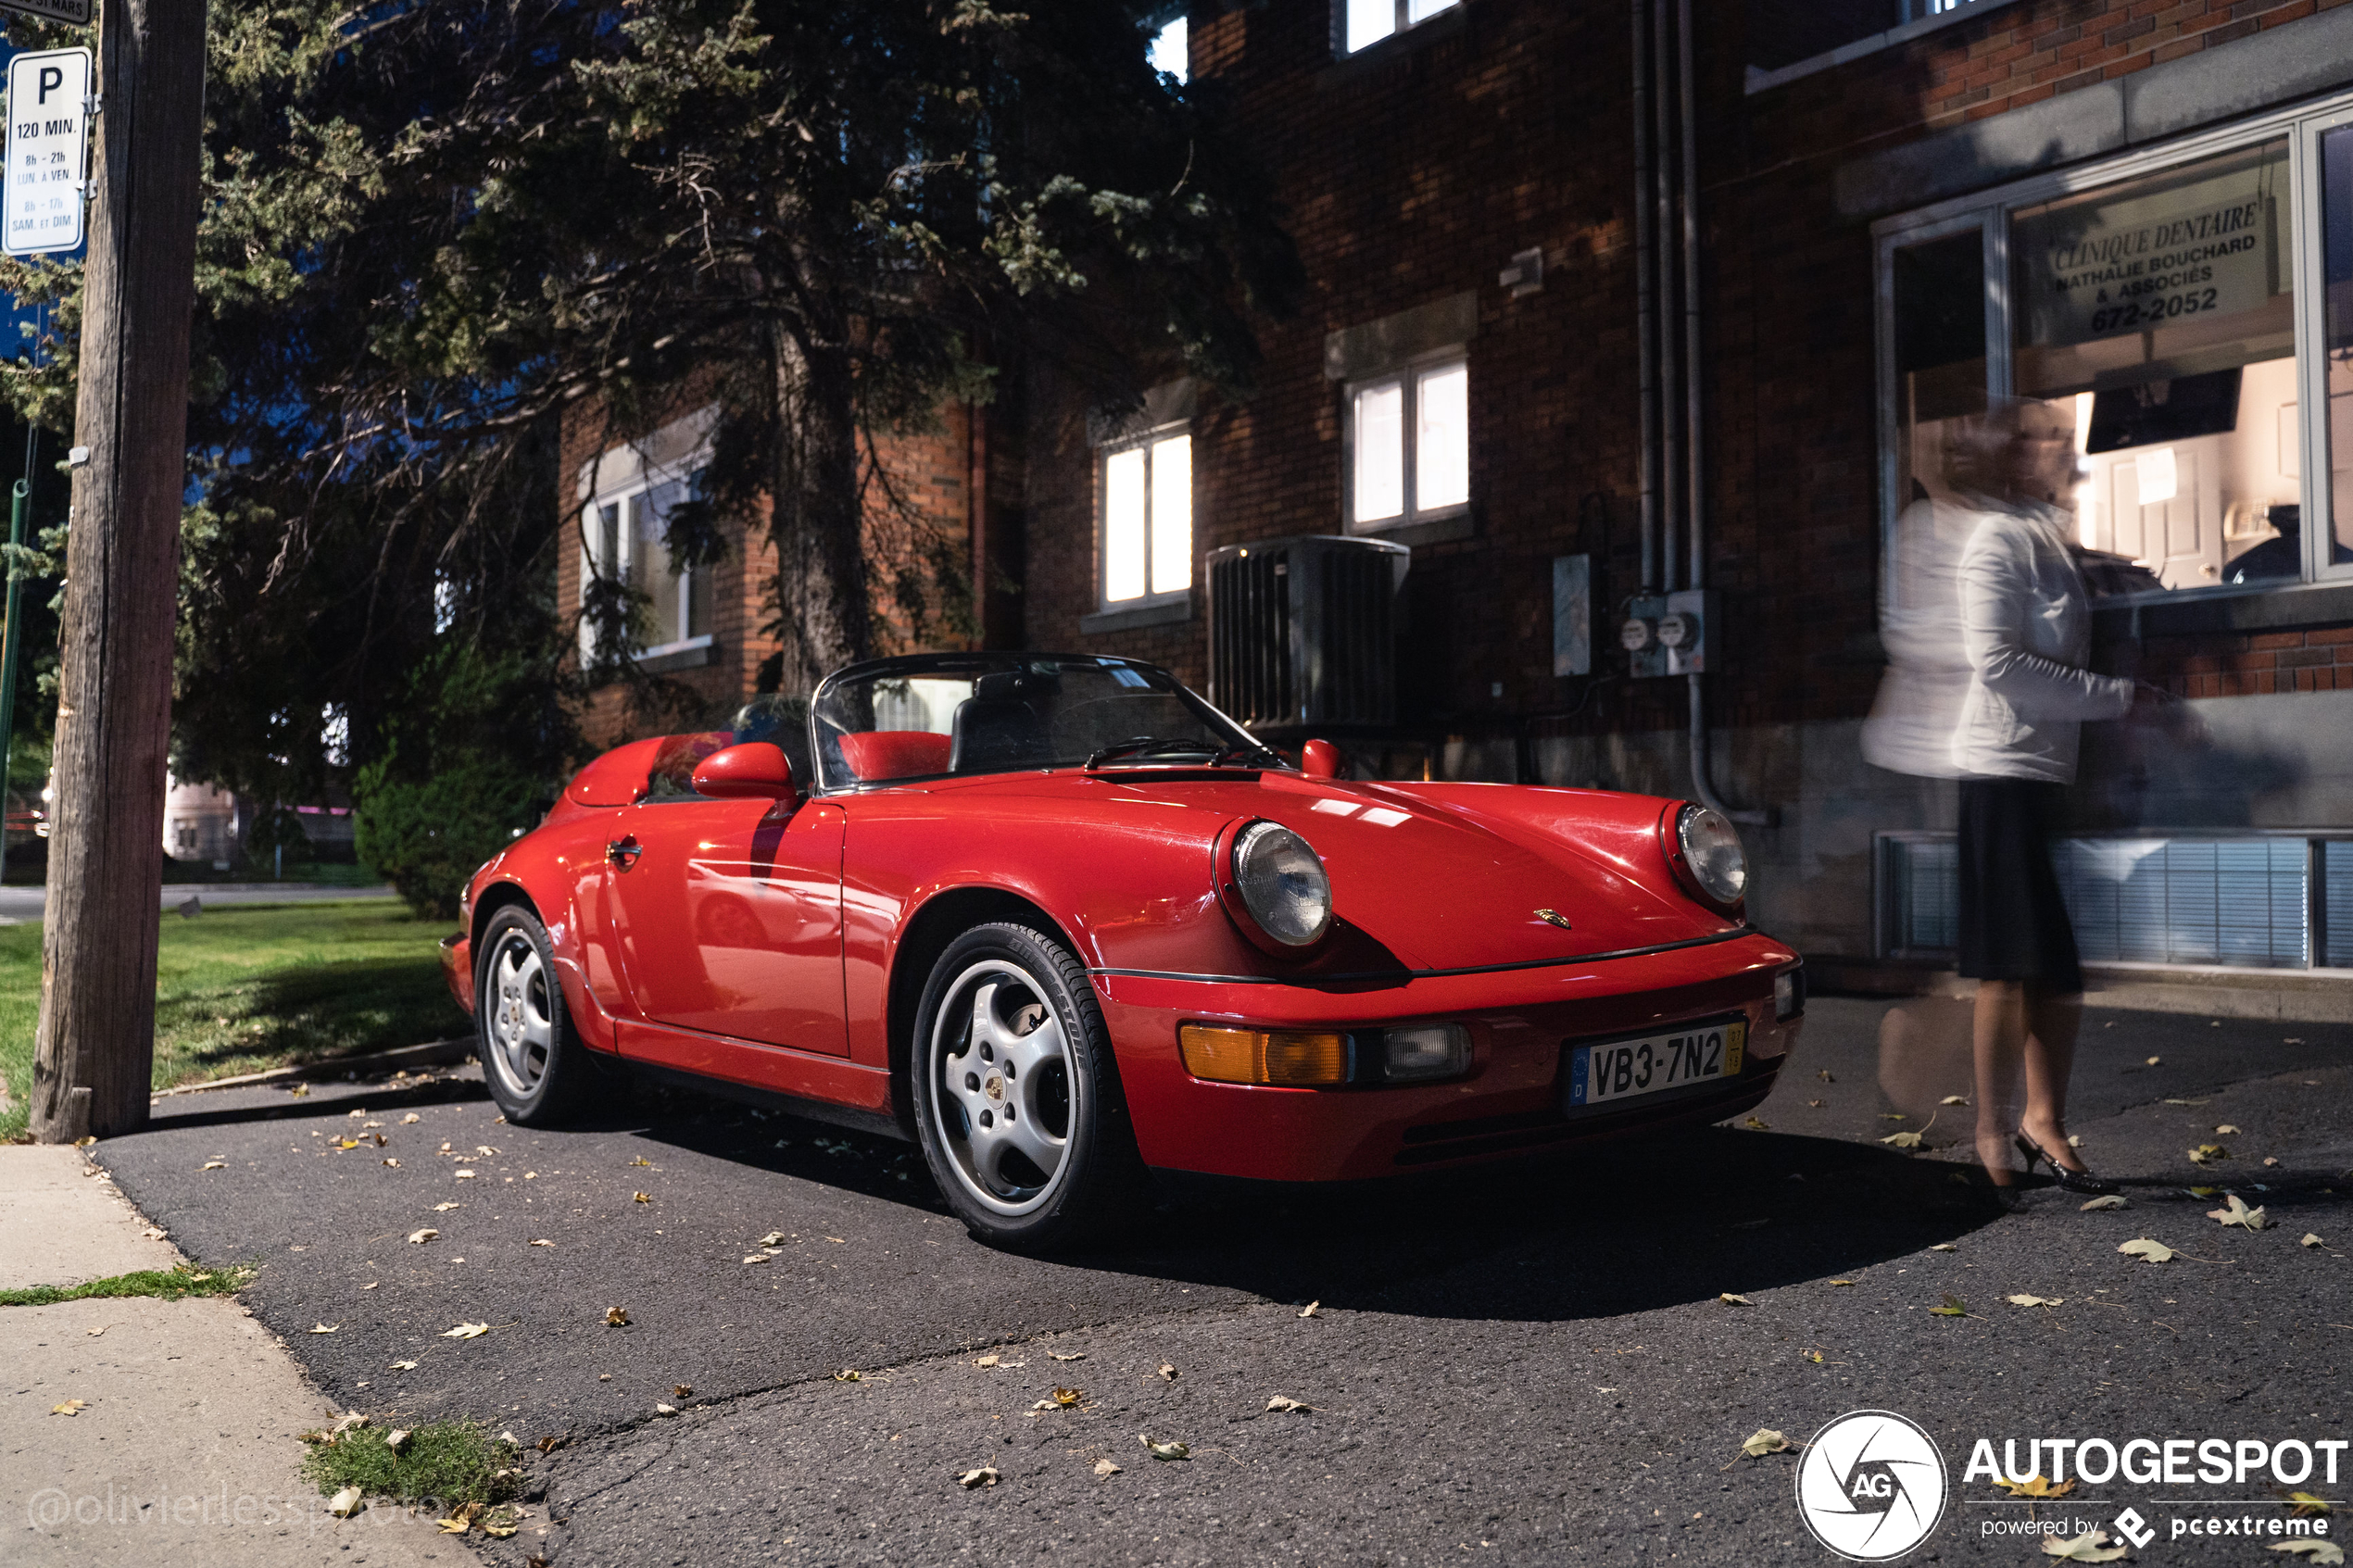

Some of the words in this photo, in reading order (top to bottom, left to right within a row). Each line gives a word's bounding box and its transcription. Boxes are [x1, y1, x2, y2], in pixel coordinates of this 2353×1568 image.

[52, 0, 82, 17] MARS
[39, 67, 63, 105] P
[18, 122, 39, 139] 120
[45, 119, 77, 136] MIN.
[26, 155, 36, 166] 8h
[51, 152, 66, 164] 21h
[18, 173, 37, 185] LUN.
[51, 169, 72, 182] VEN.
[24, 201, 35, 212] 8h
[49, 199, 63, 210] 17h
[12, 218, 36, 232] SAM.
[41, 219, 49, 228] ET
[53, 213, 74, 227] DIM.
[2055, 229, 2149, 270] CLINIQUE
[2154, 201, 2258, 248] DENTAIRE
[2056, 261, 2144, 292] NATHALIE
[2148, 235, 2256, 273] BOUCHARD
[2092, 288, 2218, 332] 672-2052
[1006, 937, 1087, 1072] BRIDGESTONE
[1595, 1033, 1721, 1096] VB3-7N2
[1575, 1084, 1582, 1098] D
